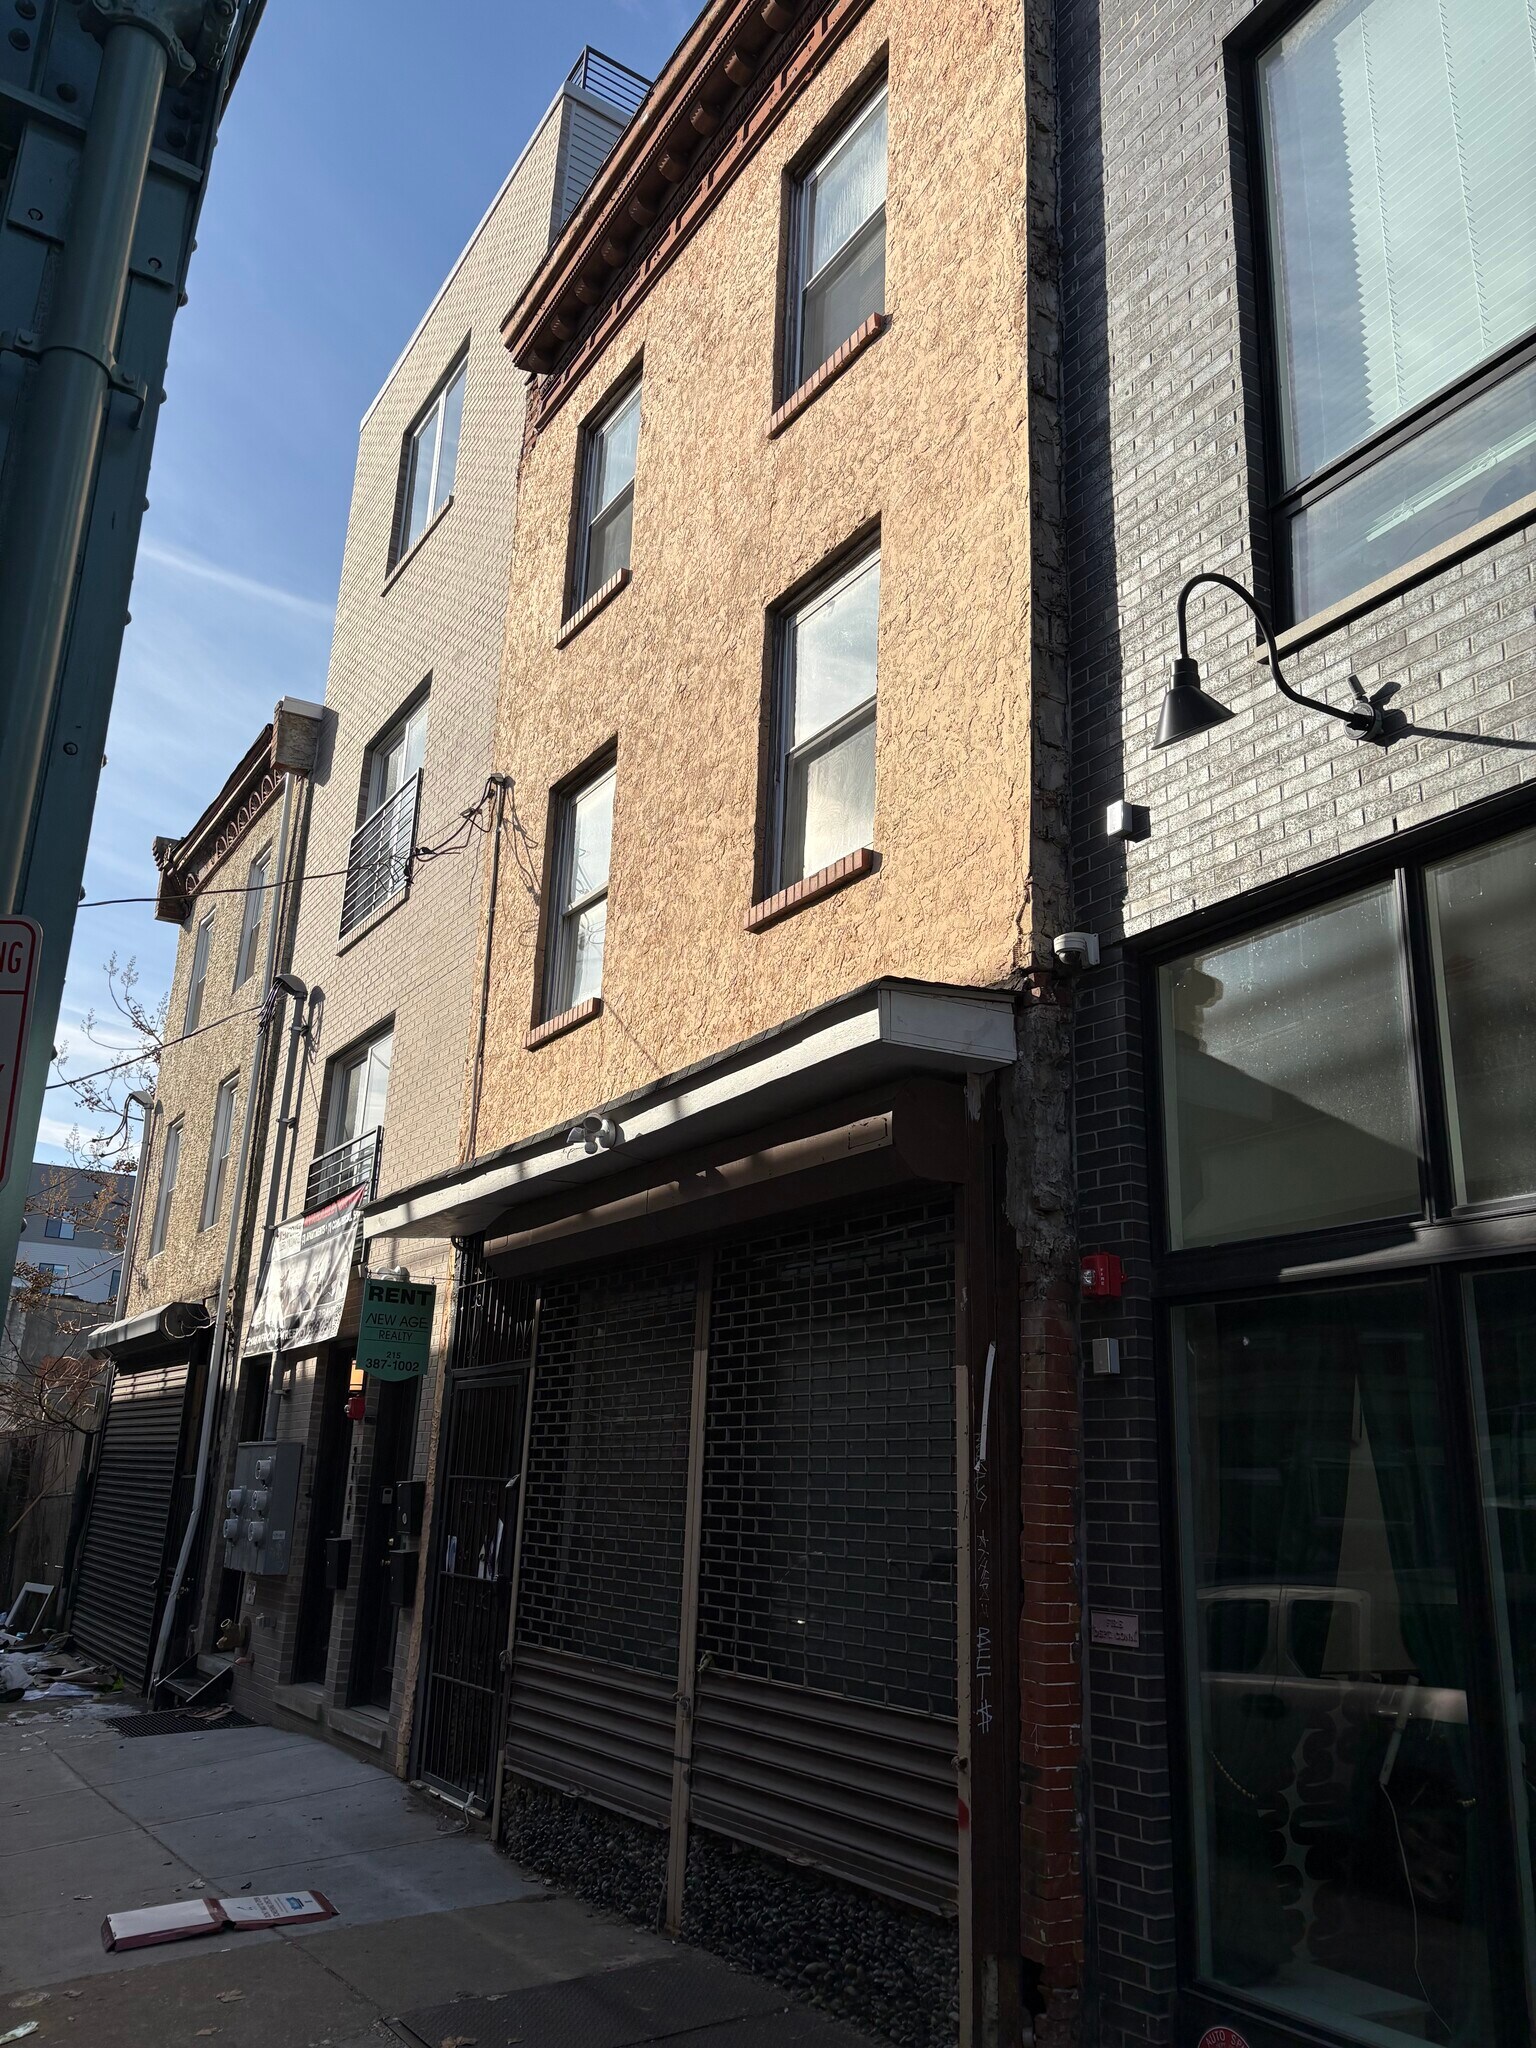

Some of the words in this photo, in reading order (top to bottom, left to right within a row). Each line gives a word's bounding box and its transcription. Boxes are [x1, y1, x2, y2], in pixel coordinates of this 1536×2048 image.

[0, 941, 24, 974] G
[368, 1285, 432, 1306] RENT
[365, 1312, 397, 1326] NEW
[399, 1316, 429, 1329] AGE
[378, 1329, 413, 1342] REALTY
[386, 1351, 401, 1359] 215
[365, 1358, 420, 1372] 387-1002
[1205, 2029, 1226, 2047] AUTO
